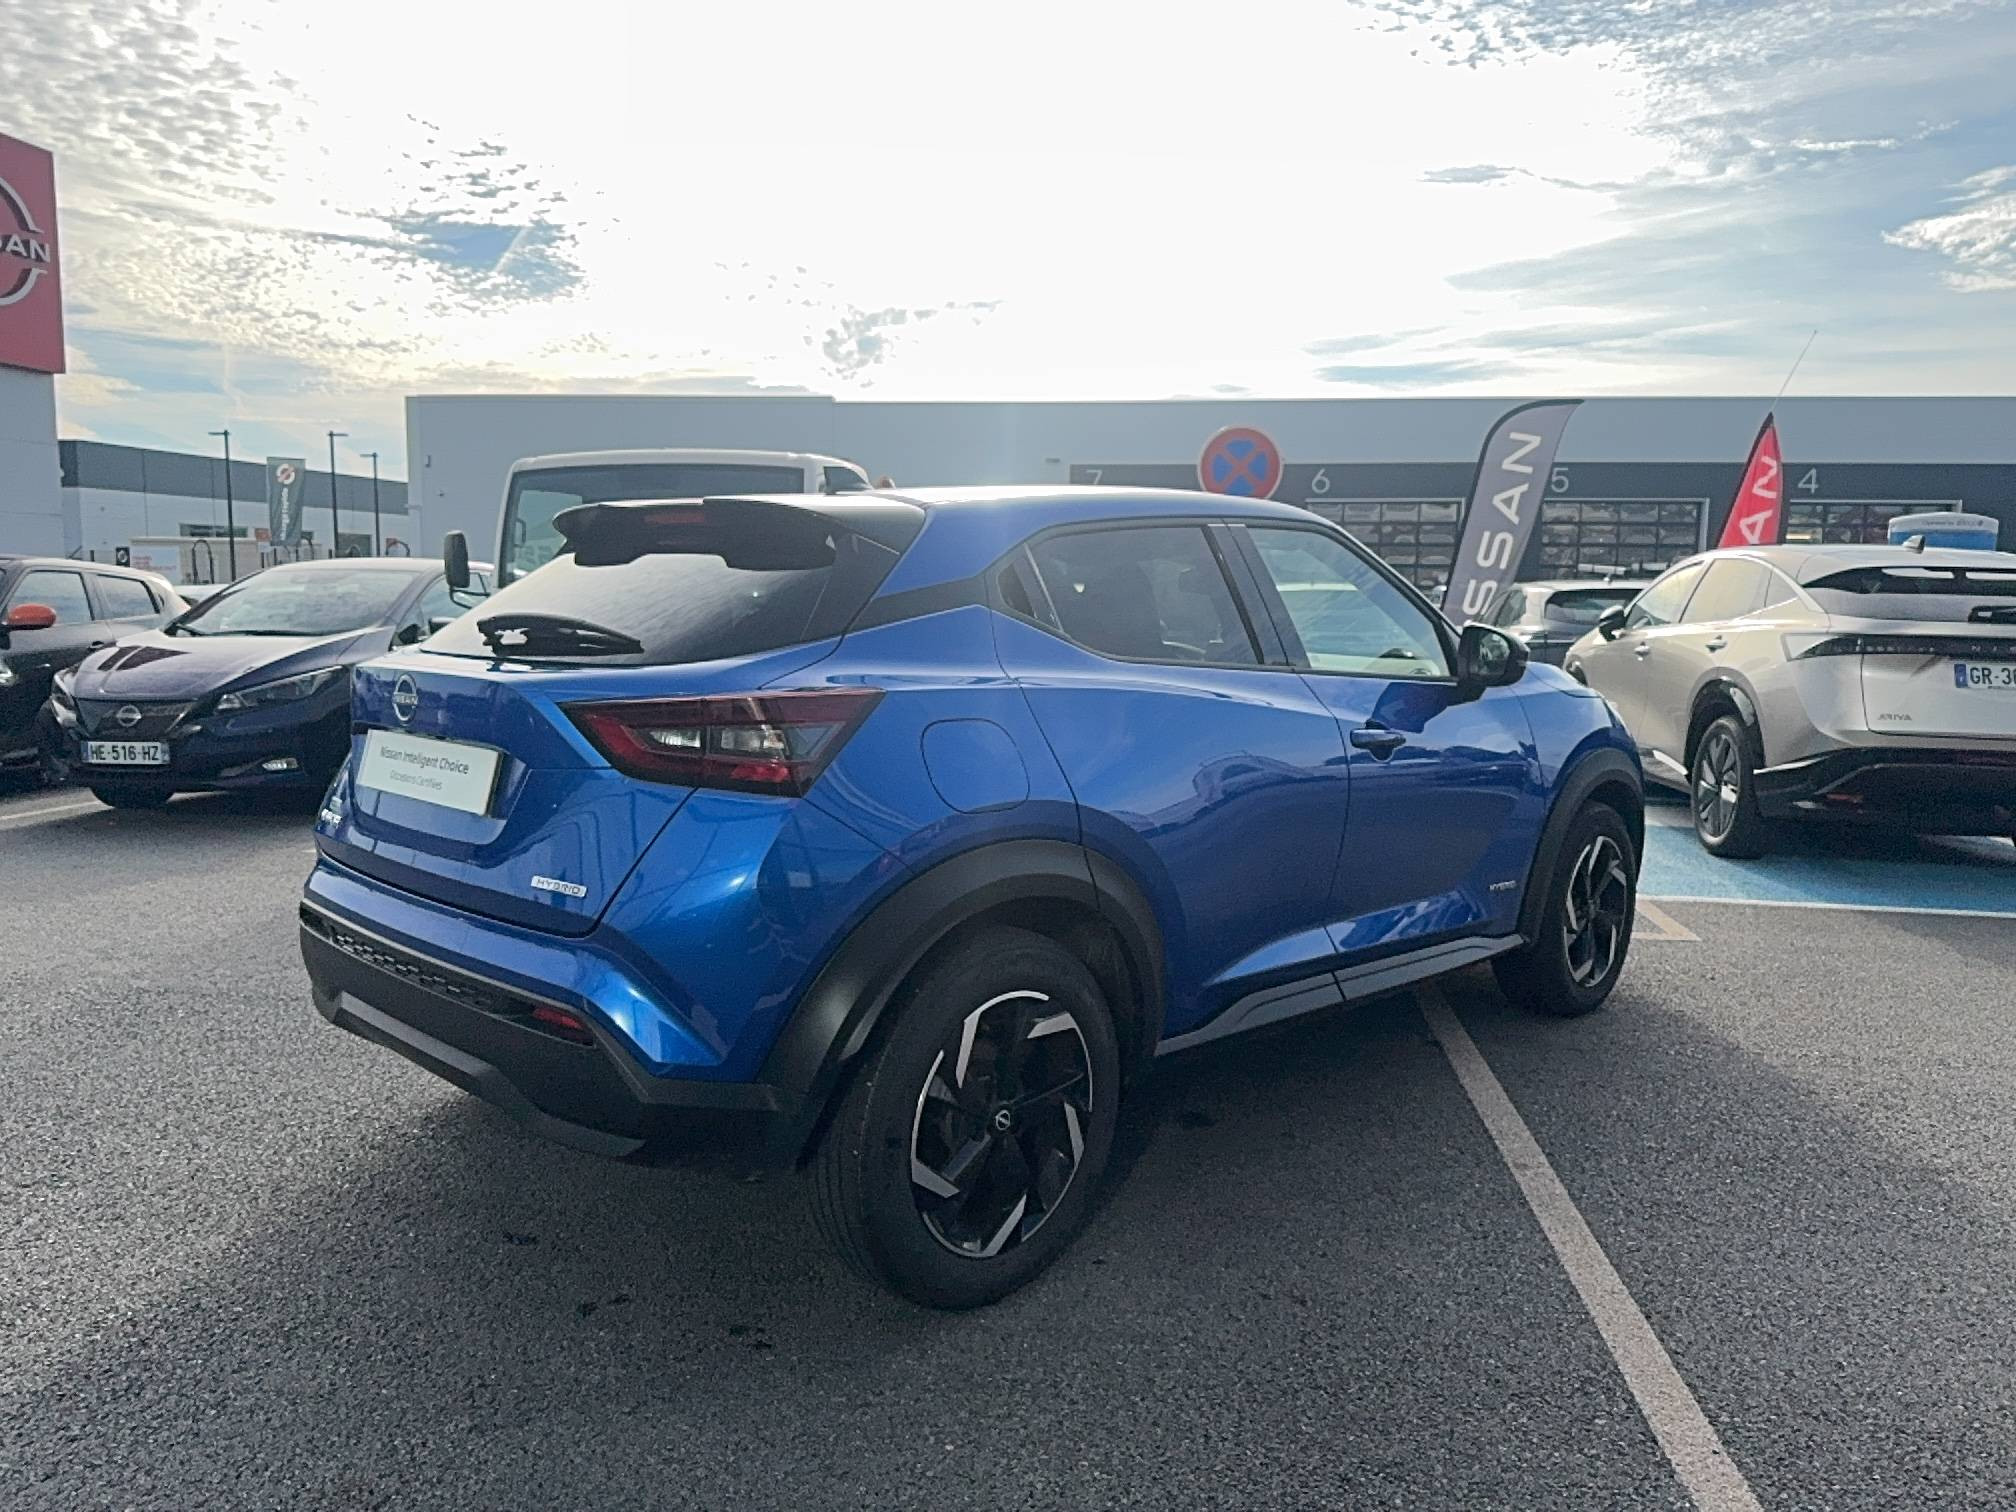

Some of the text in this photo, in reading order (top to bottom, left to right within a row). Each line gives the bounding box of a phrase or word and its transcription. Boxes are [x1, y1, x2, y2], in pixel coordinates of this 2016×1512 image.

[1310, 468, 1331, 494] 6
[1551, 467, 1569, 493] 5
[1797, 467, 1819, 494] 4
[1461, 431, 1542, 626] SSAN
[90, 745, 159, 761] HE-516-HZ
[380, 745, 469, 775] Nissan Intelligent Choice
[536, 878, 581, 895] HYBRID
